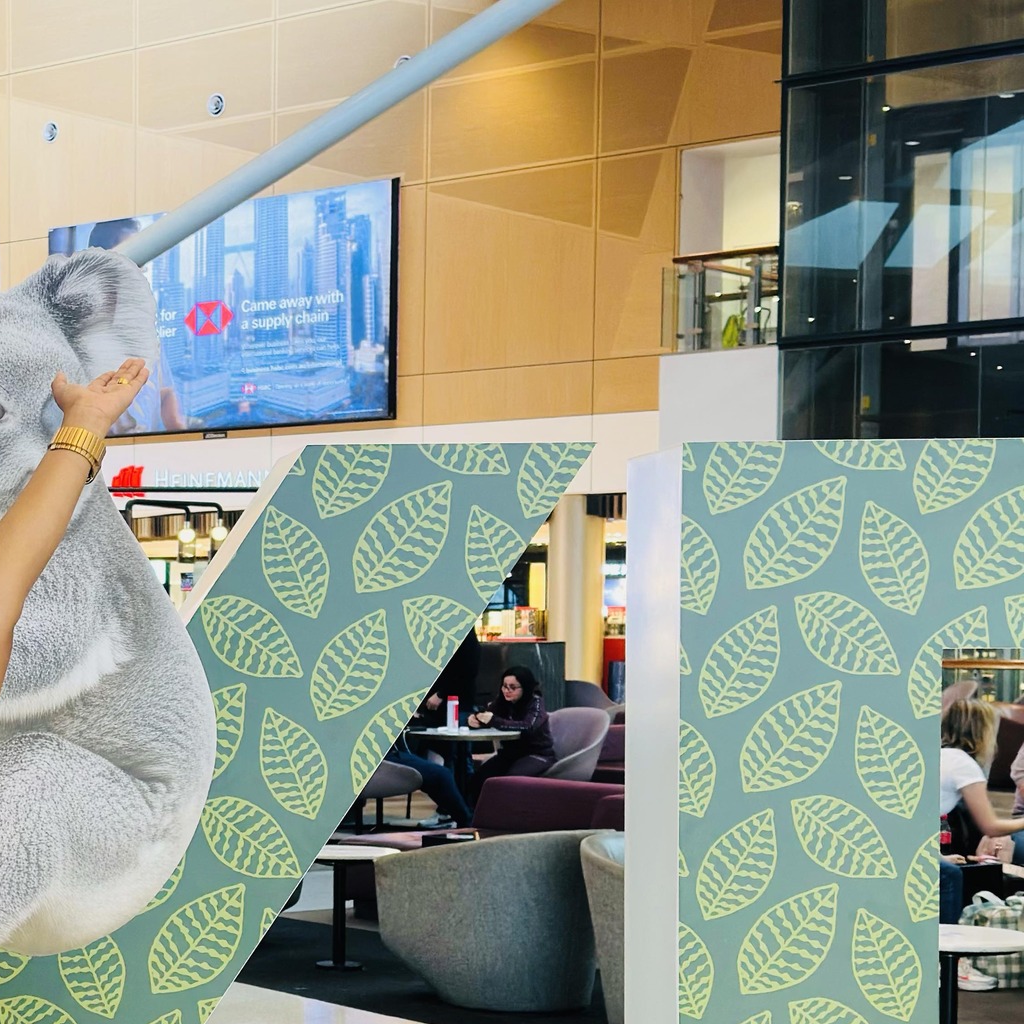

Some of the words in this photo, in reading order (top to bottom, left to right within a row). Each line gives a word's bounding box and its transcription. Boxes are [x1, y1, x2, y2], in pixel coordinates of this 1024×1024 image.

[241, 299, 277, 312] Came
[279, 295, 313, 309] away
[316, 289, 344, 305] with
[160, 308, 177, 321] for
[240, 319, 249, 330] a
[251, 312, 293, 330] supply
[295, 308, 330, 325] chain
